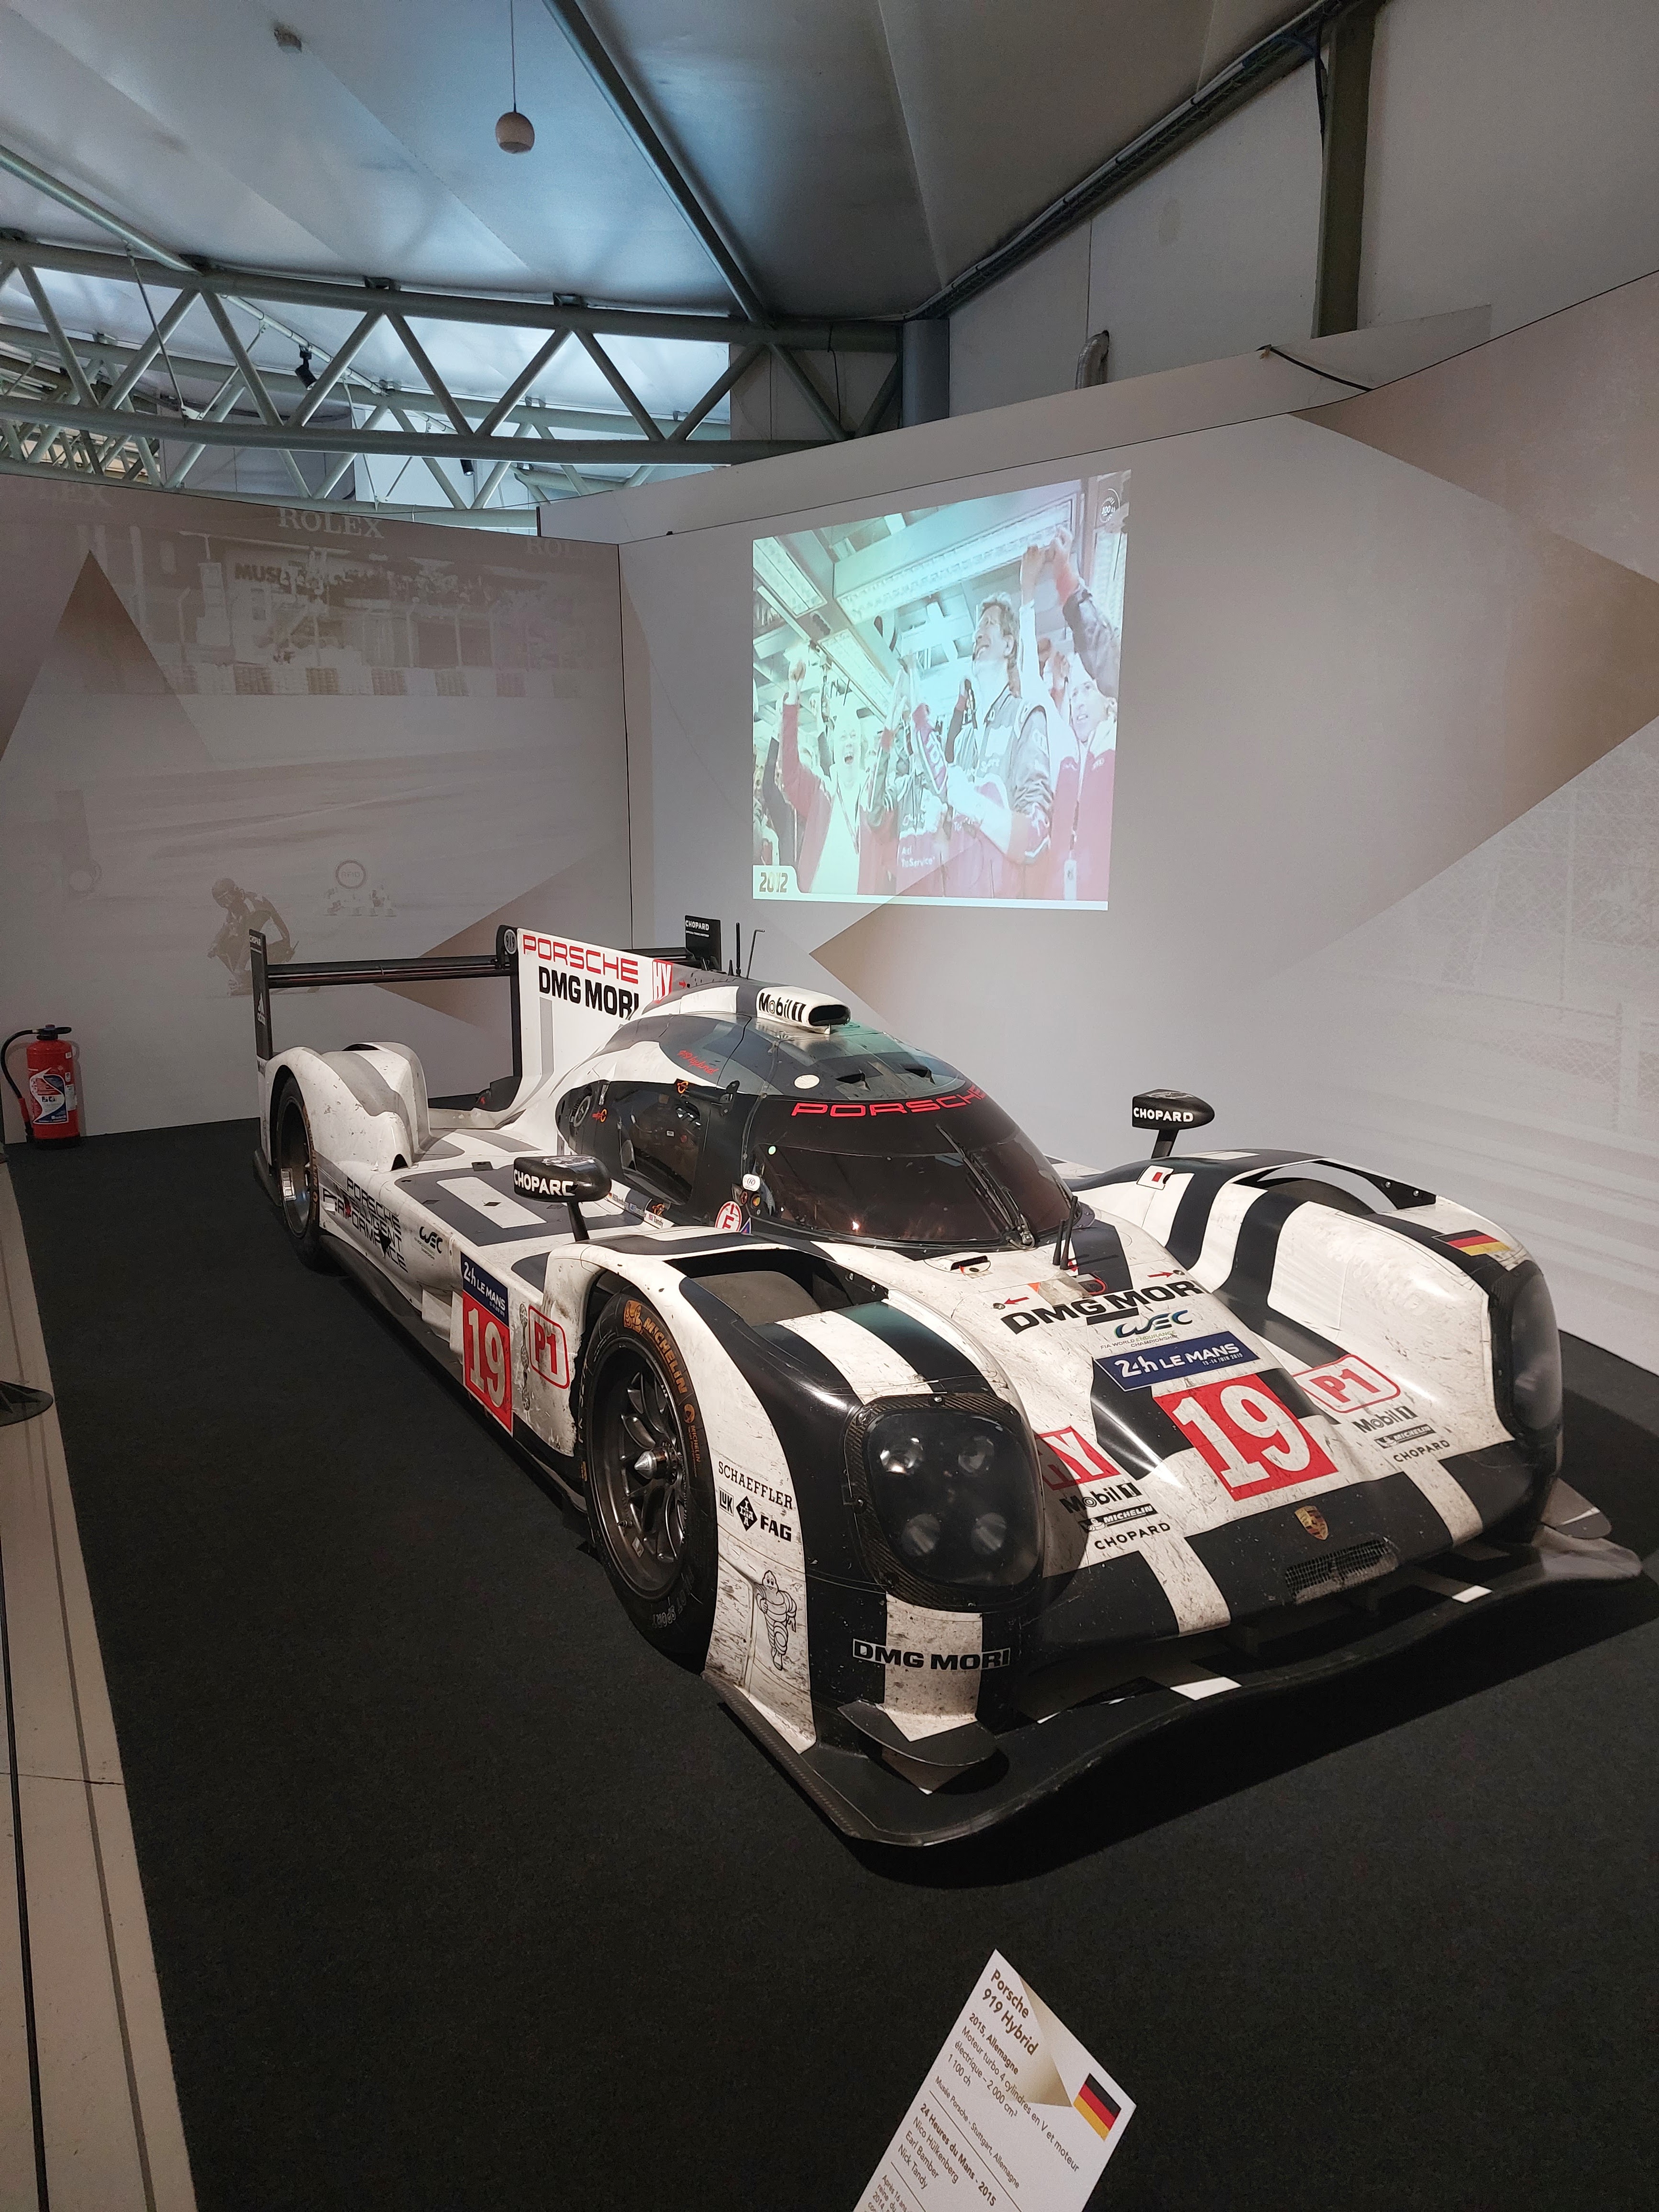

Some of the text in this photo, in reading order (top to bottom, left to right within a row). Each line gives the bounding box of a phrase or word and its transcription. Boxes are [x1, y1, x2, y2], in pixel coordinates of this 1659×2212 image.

[278, 507, 385, 539] ROLEX
[759, 872, 788, 893] 2012
[505, 934, 516, 948] 919
[685, 920, 709, 931] CHOPARD
[523, 934, 639, 985] PORSCHE
[539, 965, 582, 1005] DMG
[652, 961, 672, 1003] HY
[790, 1084, 987, 1117] PORSCHE
[1133, 1107, 1194, 1122] CHOPARD
[347, 1176, 401, 1236] PORSCHE
[419, 1226, 443, 1255] WEC
[463, 1261, 476, 1287] 24h
[476, 1278, 486, 1294] LE
[485, 1285, 507, 1312] MANS
[1000, 1280, 1205, 1335] DMG MOR
[1114, 1309, 1194, 1339] WEC
[467, 1307, 506, 1409] 19
[533, 1320, 558, 1375] P1
[642, 1316, 688, 1394] MICHELIN
[1112, 1338, 1136, 1348] WORLD
[1135, 1330, 1176, 1342] ENDURANCE
[1130, 1334, 1178, 1348] CHAMPIONSHIP
[1114, 1343, 1240, 1379] 24h LE MANS
[1309, 1368, 1382, 1404] P1
[1172, 1384, 1312, 1489] 19
[1351, 1410, 1404, 1434] Mobil
[1393, 1426, 1432, 1442] MICHELIN
[690, 1424, 701, 1463] MICHELIN
[1393, 1439, 1451, 1463] CHOPARD
[718, 1460, 793, 1510] SCHAEFFLER
[1059, 1486, 1123, 1514] Mobil
[760, 1514, 792, 1543] FAG
[1103, 1505, 1154, 1524] MICHELIN
[1094, 1522, 1171, 1550] CHOPARD
[854, 1639, 1011, 1671] DMG MORI
[990, 1968, 1029, 2019] Porsche
[982, 1988, 1039, 2056] 919 Hybrid
[948, 2054, 972, 2087] 1 100 ch
[954, 2040, 983, 2078] électrique
[986, 2080, 994, 2090] 2
[992, 2088, 1006, 2104] 000
[985, 2034, 1019, 2075] Allemagne
[962, 2025, 1080, 2172] Moteur turbo 4 cylindres en V et moteur
[912, 2116, 959, 2185] Nico Hülkenberg
[935, 2075, 951, 2099] Musée
[950, 2093, 969, 2122] Porsche
[970, 2122, 993, 2157] Stuttgart,
[992, 2152, 1020, 2190] Allemagne
[897, 2143, 928, 2190] Nick Tandy
[905, 2130, 940, 2179] Earl Bamber
[919, 2102, 930, 2117] 24
[929, 2113, 950, 2146] Heures
[949, 2143, 959, 2158] du
[958, 2153, 975, 2180] Mans
[978, 2181, 997, 2207] 2015
[877, 2184, 889, 2201] reine
[882, 2174, 907, 2212] Après 16 ans
